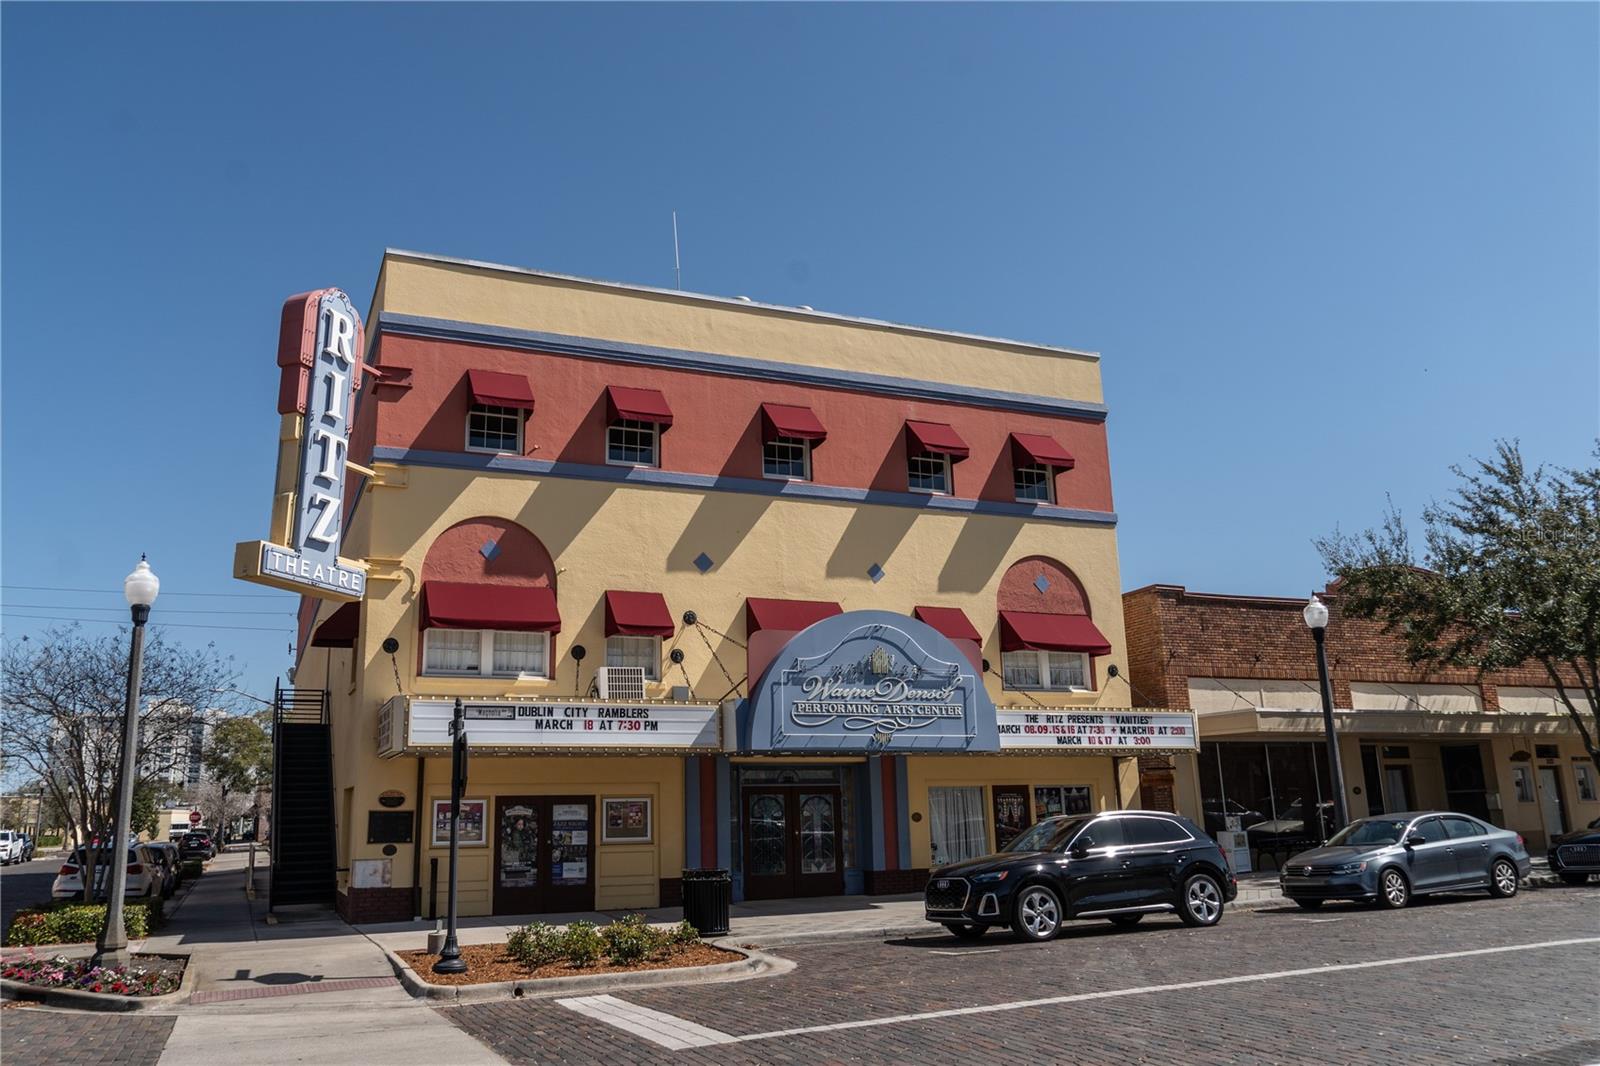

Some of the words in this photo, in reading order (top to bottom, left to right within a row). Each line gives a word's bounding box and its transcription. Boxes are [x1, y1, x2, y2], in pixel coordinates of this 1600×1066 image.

[309, 308, 355, 544] RITZ
[272, 551, 361, 590] THEATRE
[802, 675, 876, 701] Wayne
[518, 706, 554, 717] DUBLIN
[564, 707, 588, 718] CITY
[598, 708, 649, 719] RAMBLERS
[797, 703, 879, 714] PERFORMING
[883, 704, 914, 714] ARTS
[917, 705, 962, 715] CENTER
[535, 719, 573, 730] MARCH
[584, 720, 594, 731] 18
[599, 720, 613, 730] AT
[618, 720, 641, 731] 7:30
[644, 721, 658, 731] PM
[1025, 714, 1039, 724] THE
[1046, 714, 1063, 724] RITZ
[1067, 714, 1104, 724] PRESENTS
[1077, 725, 1087, 734] AT
[1158, 726, 1168, 735] AT
[1056, 736, 1082, 745] MARCH
[1118, 737, 1128, 745] AT
